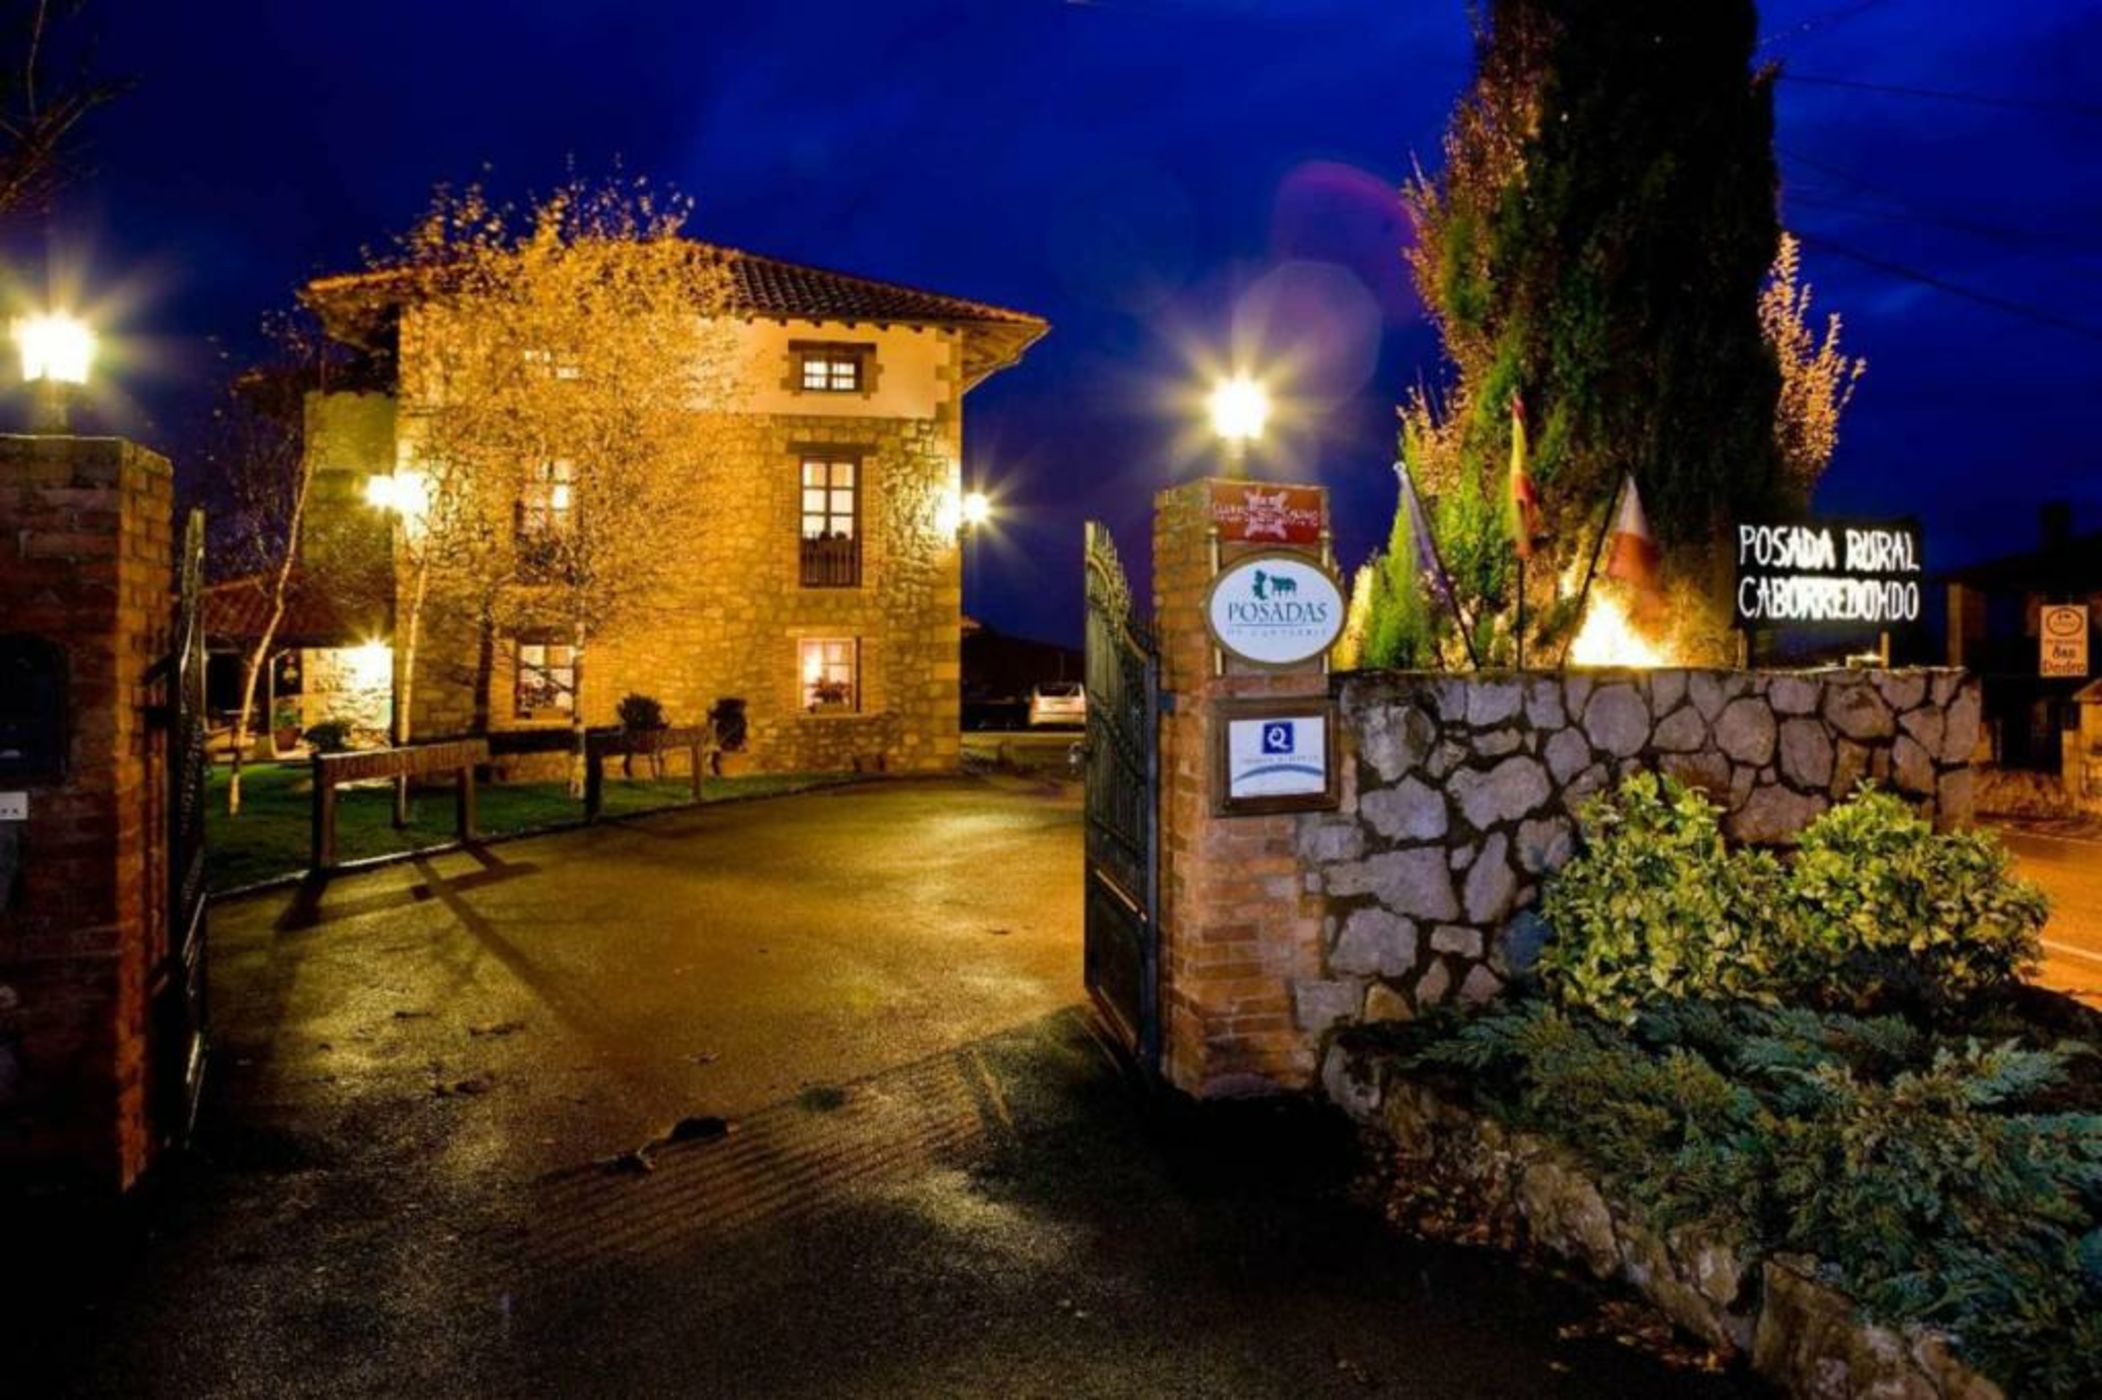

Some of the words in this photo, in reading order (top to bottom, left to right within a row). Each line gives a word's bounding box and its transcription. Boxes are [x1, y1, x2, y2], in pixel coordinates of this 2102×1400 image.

[1739, 524, 1836, 570] POSADA
[1845, 528, 1921, 571] RURAL
[1228, 602, 1327, 623] POSADAS
[1738, 574, 1920, 622] CABORREDONDO
[1267, 726, 1291, 751] Q
